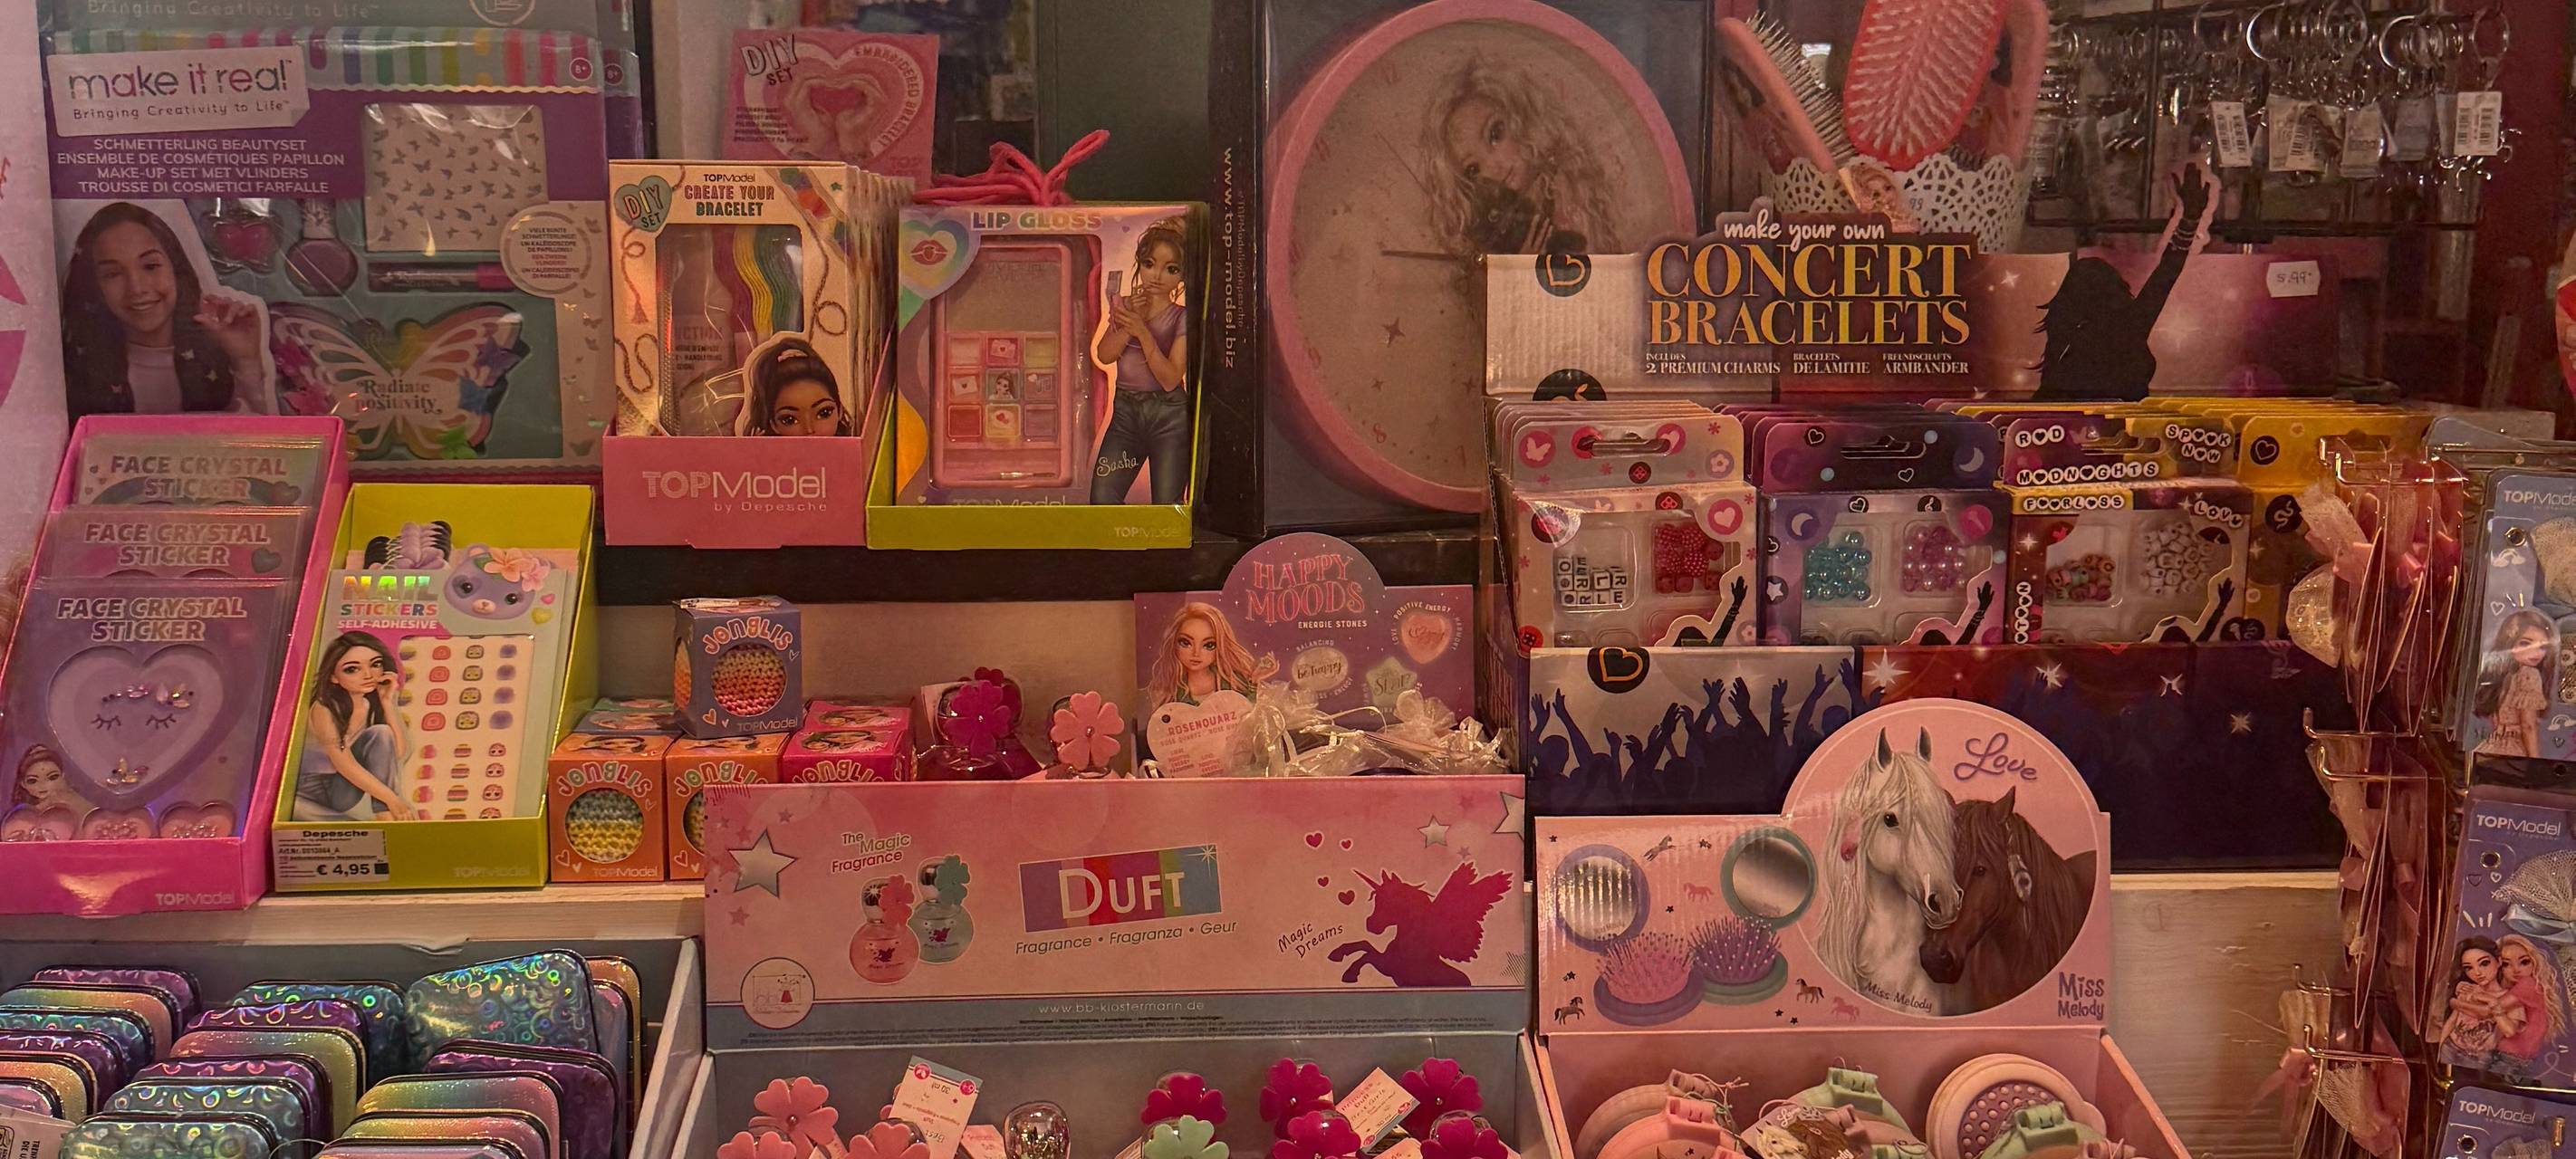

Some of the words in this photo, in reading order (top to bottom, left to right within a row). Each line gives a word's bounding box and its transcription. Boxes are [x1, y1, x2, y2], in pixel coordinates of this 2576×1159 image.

[89, 0, 175, 17] Bringing
[189, 0, 293, 18] Creativity
[305, 4, 327, 16] to
[740, 34, 799, 76] DIY
[69, 65, 178, 100] make
[188, 62, 207, 94] it
[766, 67, 793, 86] SET
[73, 108, 139, 120] Bringing
[147, 104, 226, 117] Creativity
[235, 103, 248, 113] to
[93, 139, 217, 151] SCHMETTERLING
[222, 139, 308, 151] BEAUTYSET
[58, 153, 137, 166] ENSEMBLE
[139, 153, 159, 166] DE
[272, 153, 345, 166] PAPILLON
[97, 168, 167, 179] MAKE-UP
[170, 168, 199, 179] SET
[202, 168, 232, 179] MET
[234, 168, 309, 179] VLINDERS
[703, 173, 755, 183] TOPModel
[79, 181, 149, 194] TROUSSE
[152, 181, 169, 194] DI
[172, 181, 253, 194] COSMETICI
[255, 181, 330, 194] FARFALLE
[684, 184, 734, 201] CREATE
[740, 184, 775, 201] YOUR
[623, 184, 664, 220] DIY
[696, 201, 764, 217] BRACELET
[641, 212, 662, 228] SET
[971, 210, 1012, 232] LIP
[1017, 210, 1104, 232] GLOSS
[1724, 209, 1782, 240] make
[1790, 222, 1837, 254] your
[1843, 224, 1886, 240] own
[1647, 243, 1972, 298] CONCERT
[1647, 300, 1971, 347] BRACELETS
[1646, 352, 1687, 361] INCLUDES
[1793, 352, 1841, 361] BRACELETS
[1882, 352, 1952, 361] FREUNDSCHAFTS
[1646, 363, 1657, 374] 2
[1659, 362, 1722, 374] PREMIUM
[1724, 362, 1782, 374] CHARMS
[1793, 362, 1812, 374] DE
[110, 455, 172, 475] FACE
[179, 455, 288, 476] CRYSTAL
[1096, 450, 1139, 478] Sasha
[143, 477, 251, 499] STICKER
[642, 466, 827, 499] TOPModel
[714, 501, 733, 514] by
[741, 501, 828, 514] Depesche
[85, 523, 150, 543] FACE
[157, 523, 271, 543] CRYSTAL
[119, 546, 230, 567] STICKER
[1254, 553, 1354, 590] HAPPY
[342, 575, 438, 600] NAIL
[56, 598, 127, 619] FACE
[129, 596, 247, 618] CRYSTAL
[341, 603, 438, 617] STICKERS
[1245, 580, 1366, 624] MOODS
[91, 619, 206, 642] STICKER
[337, 619, 438, 629] SELF-ADHESIVE
[1336, 619, 1368, 628] STONES
[738, 717, 799, 733] TOPModel
[1954, 732, 2038, 781] Love
[2475, 814, 2562, 837] TOPModel
[842, 832, 864, 846] The
[860, 833, 911, 854] Magic
[316, 864, 327, 876] €
[332, 863, 370, 877] 4,95
[592, 866, 658, 877] TOPModel
[831, 850, 903, 874] Fragrance
[155, 892, 236, 905] TOPModel
[1014, 936, 1092, 955] Fragrance
[1110, 926, 1183, 946] Fragranza
[1200, 920, 1238, 935] Geur
[1278, 923, 1313, 953] Magic
[1295, 924, 1343, 959] Dreams
[2058, 971, 2105, 1001] Miss
[1865, 981, 1890, 1001] Miss
[1893, 992, 1934, 1013] Melody
[2057, 1000, 2105, 1021] Melody
[2458, 1100, 2537, 1125] TOPModel
